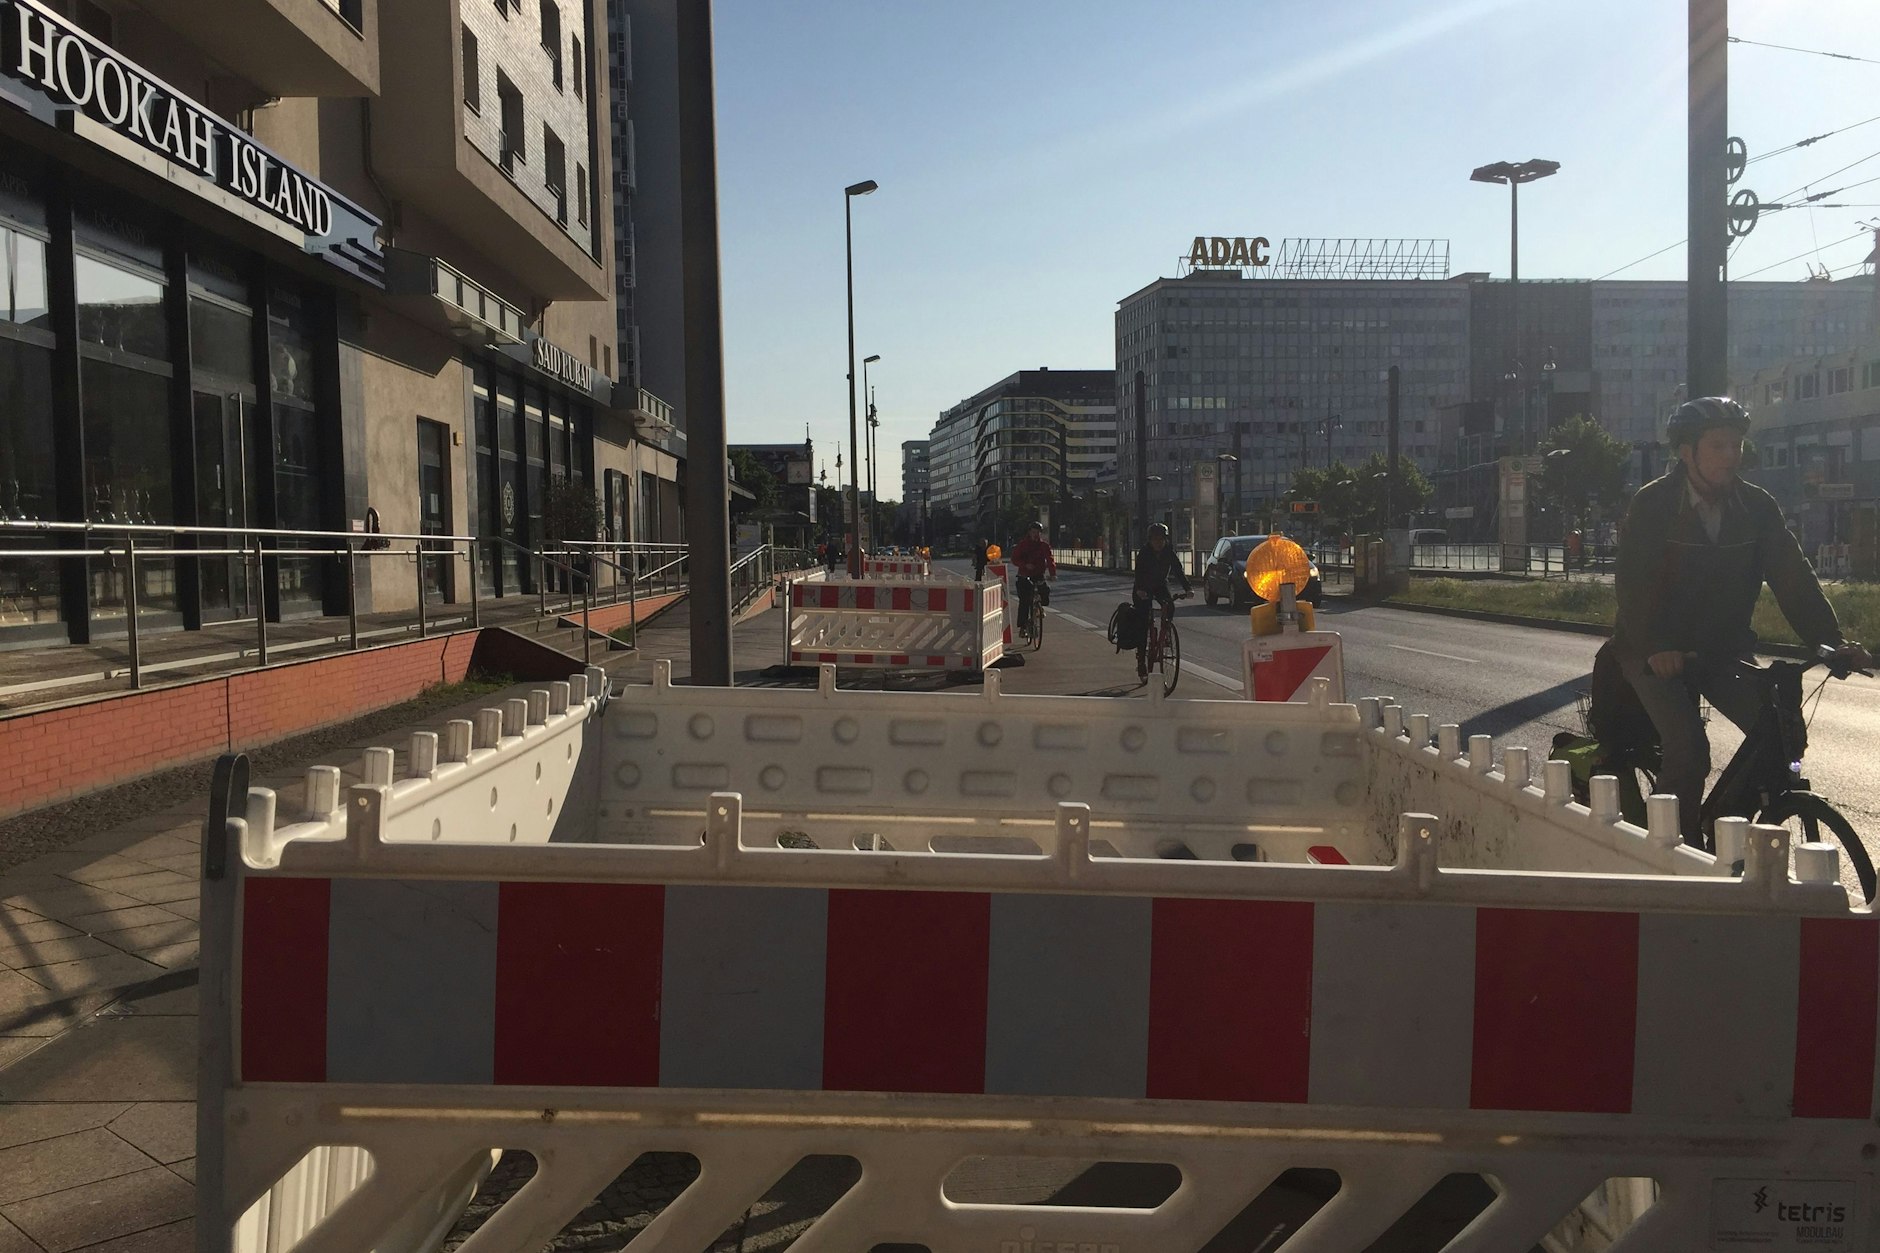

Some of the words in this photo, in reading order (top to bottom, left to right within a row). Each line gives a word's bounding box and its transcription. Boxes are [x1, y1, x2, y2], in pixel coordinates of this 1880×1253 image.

[15, 2, 217, 177] HOOKAH
[229, 134, 332, 237] ISLAND
[1190, 236, 1270, 265] ADAC
[537, 337, 561, 373] SAID
[1777, 1202, 1846, 1223] tetris
